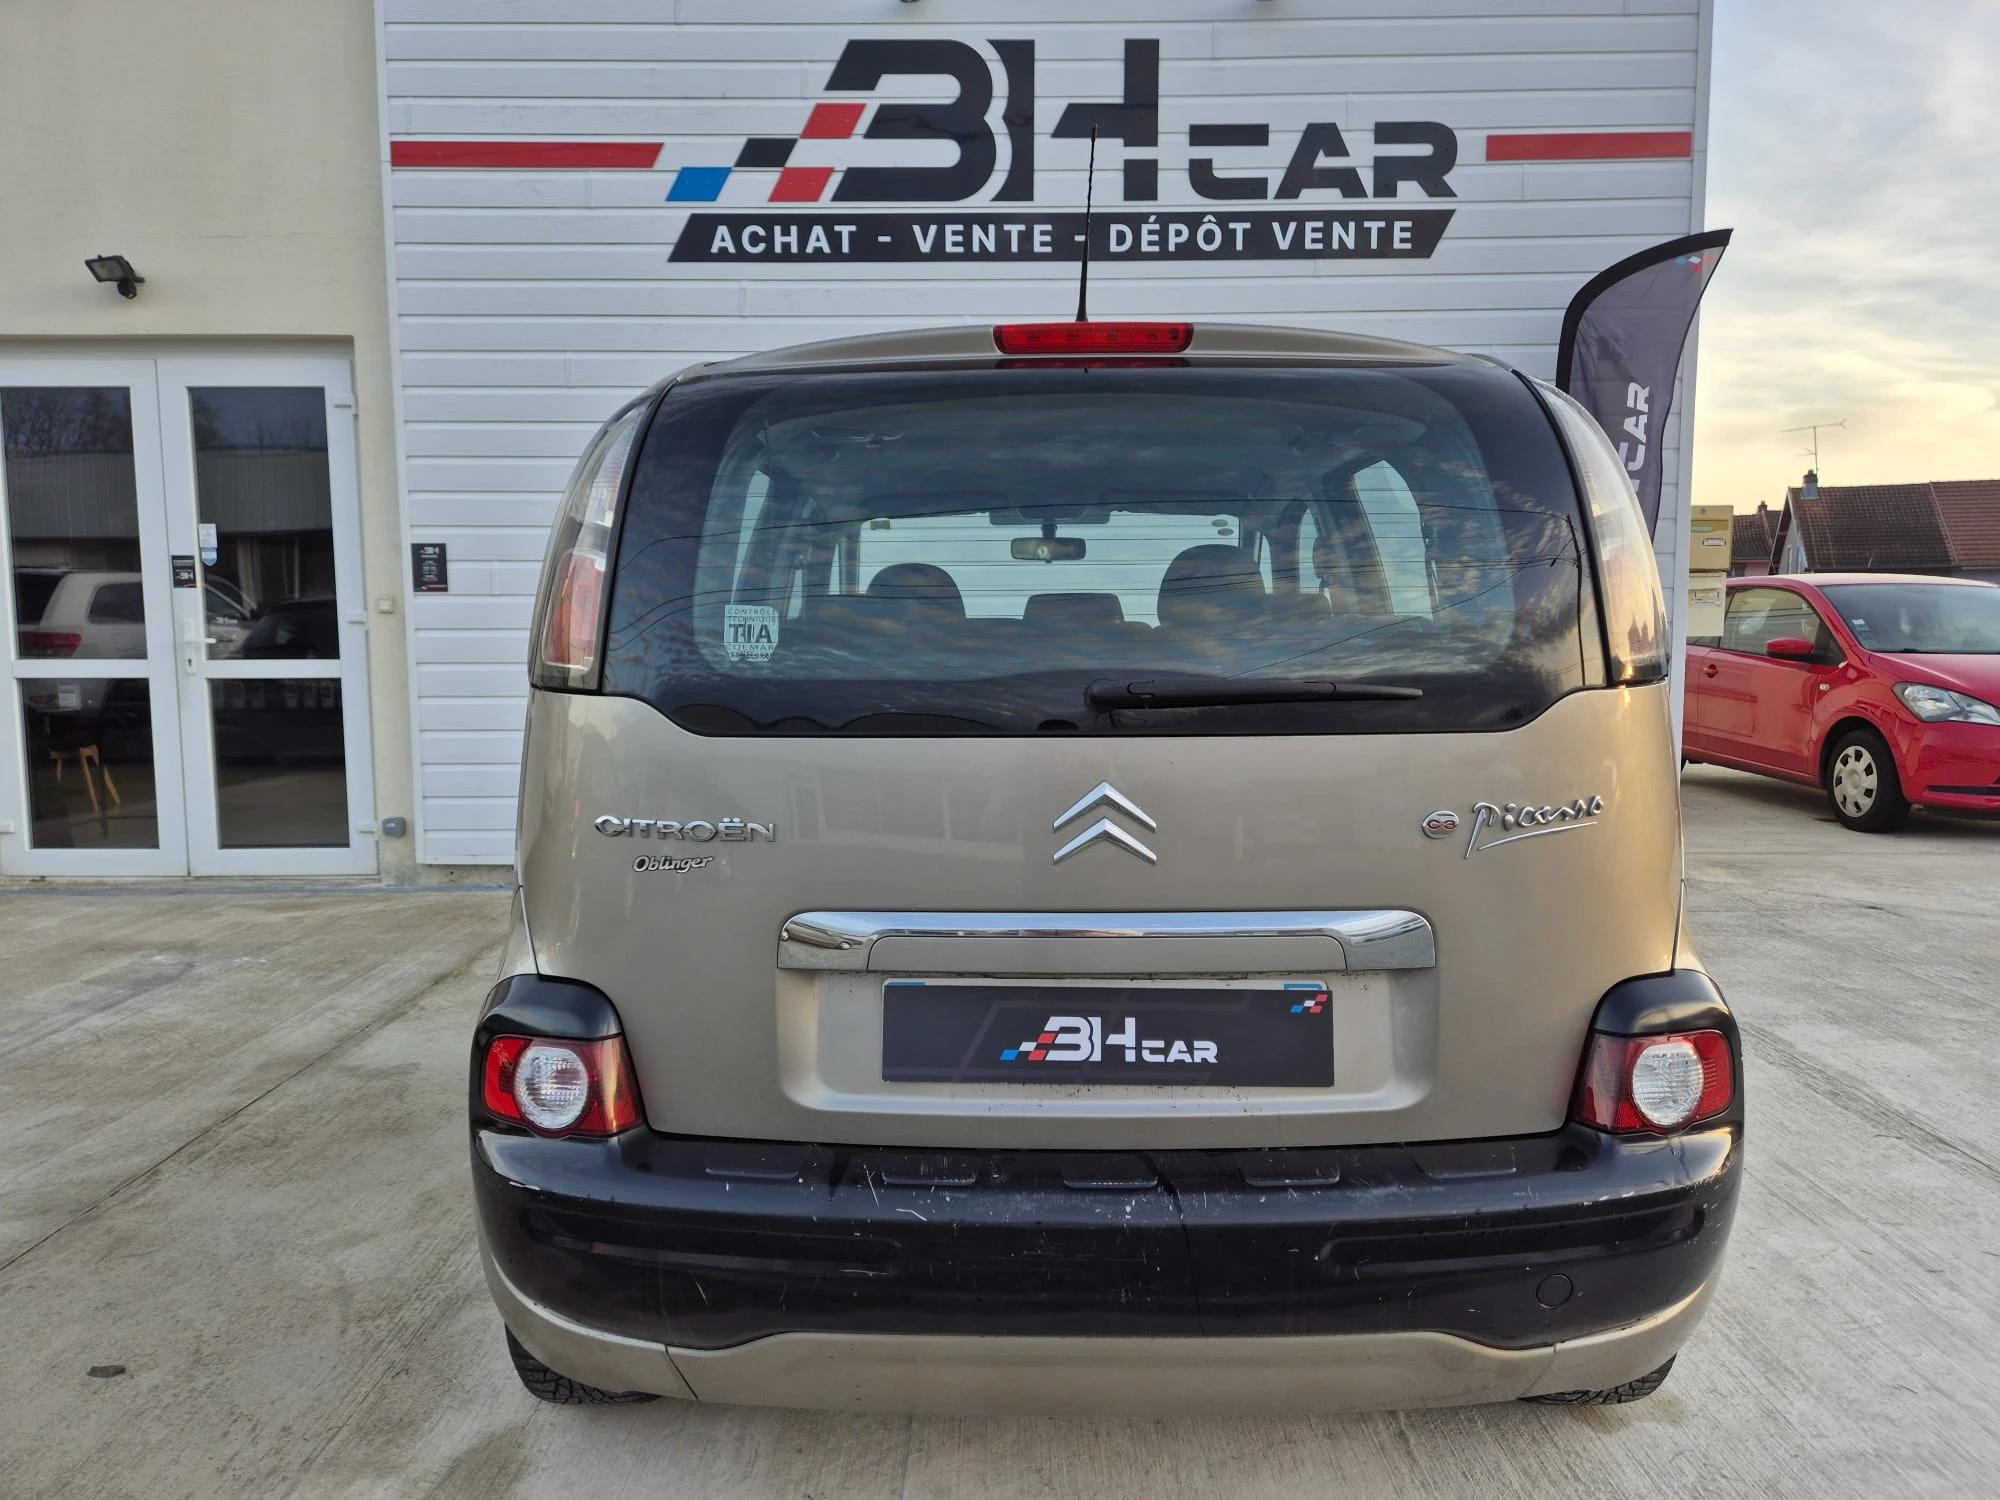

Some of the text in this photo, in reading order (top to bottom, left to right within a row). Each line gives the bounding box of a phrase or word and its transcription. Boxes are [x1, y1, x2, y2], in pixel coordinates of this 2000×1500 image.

[710, 224, 857, 255] ACHAT
[911, 223, 1054, 253] VENTE
[1108, 213, 1252, 252] DÉPÔT
[1273, 219, 1414, 250] VENTE
[594, 815, 776, 842] CITROËN
[1464, 795, 1604, 859] Picasso
[632, 855, 713, 873] Oblinger
